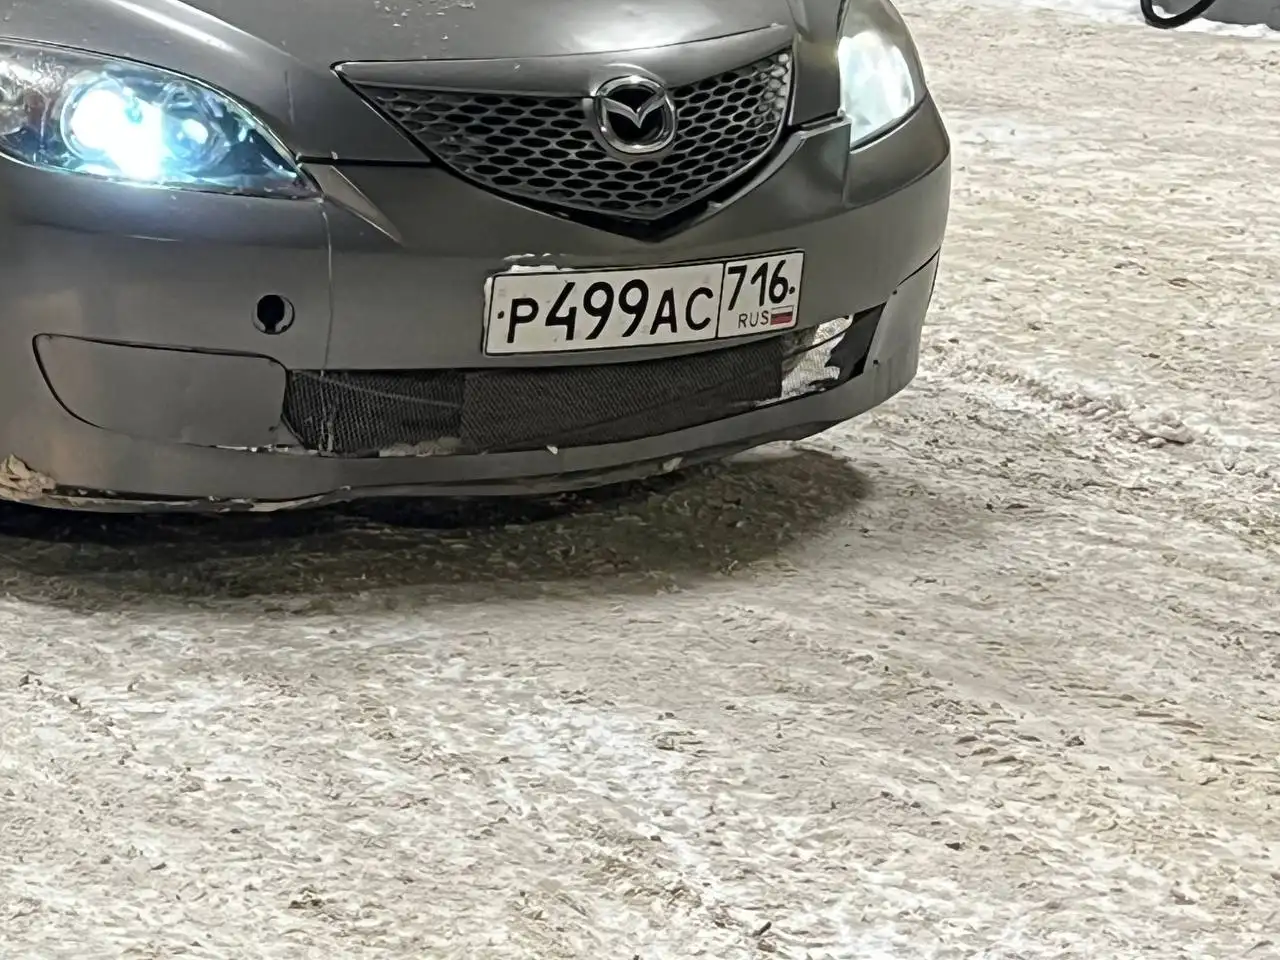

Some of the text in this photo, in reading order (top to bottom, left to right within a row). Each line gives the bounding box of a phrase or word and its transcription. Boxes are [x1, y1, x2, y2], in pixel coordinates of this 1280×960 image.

[507, 259, 790, 344] Р499АС 716
[737, 311, 770, 329] RUS
